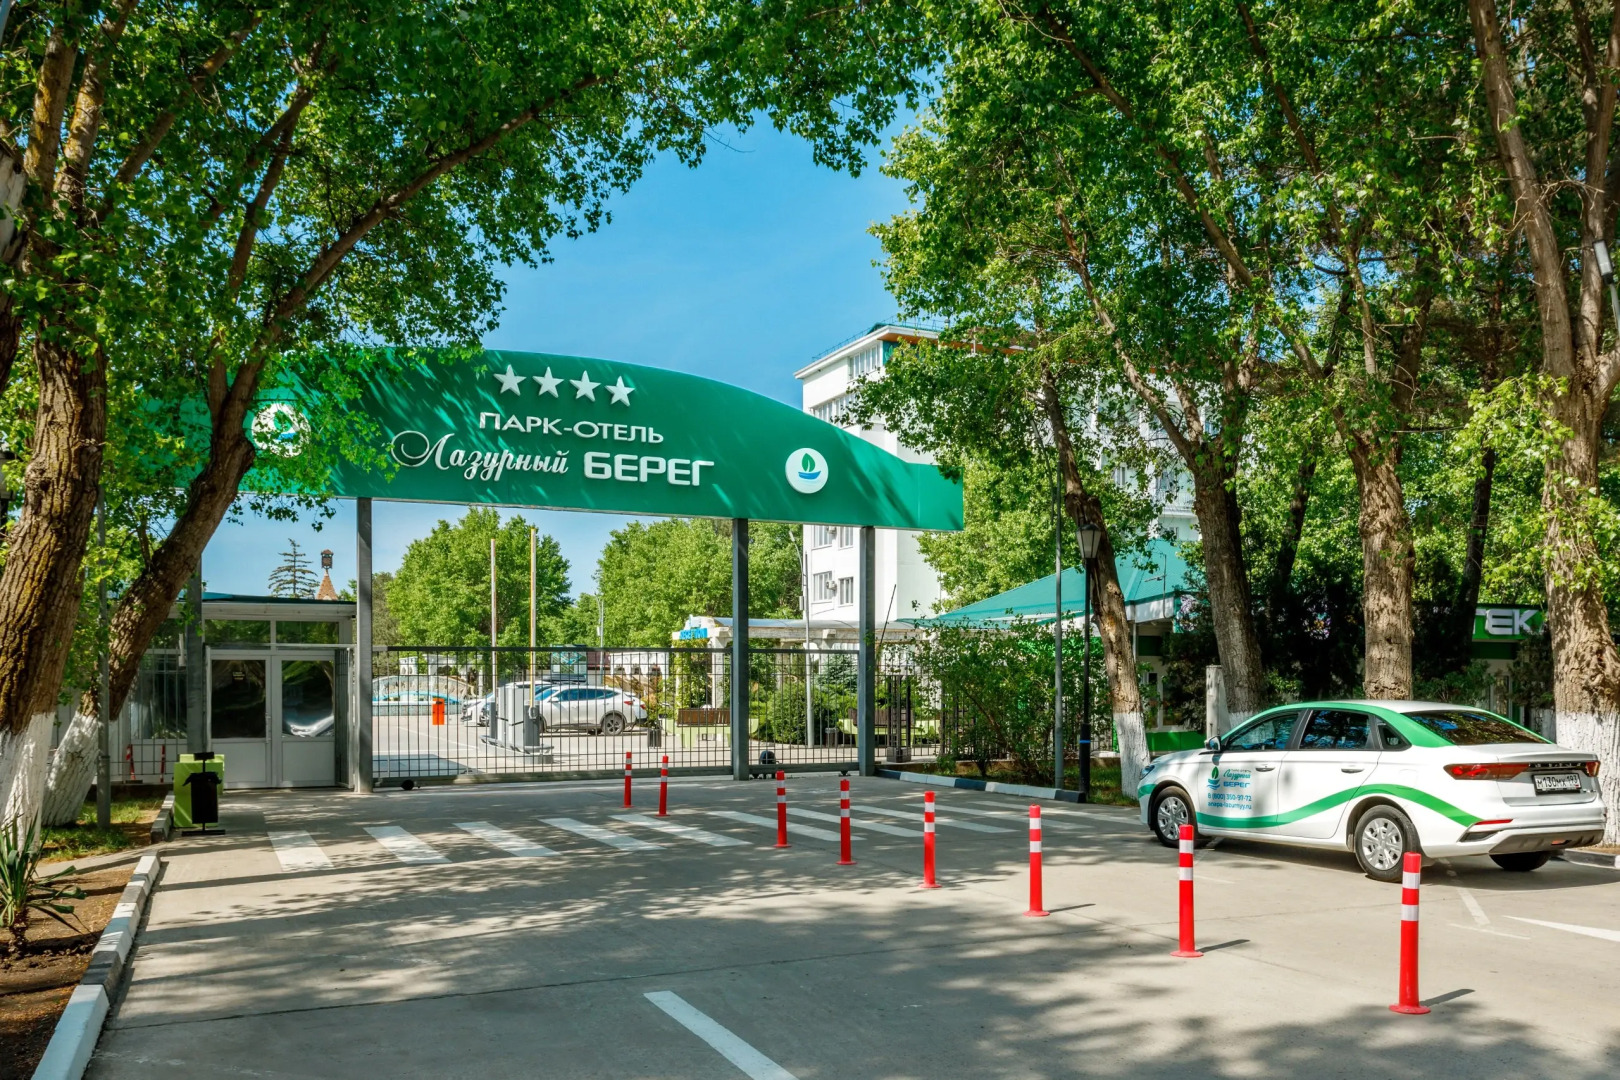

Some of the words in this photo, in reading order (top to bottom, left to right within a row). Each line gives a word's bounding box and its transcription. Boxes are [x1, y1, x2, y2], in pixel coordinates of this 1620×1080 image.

[479, 411, 664, 444] ПАРК-ОТЕЛЬ
[390, 430, 569, 482] Лазурный
[584, 451, 715, 486] БЕРЕГ
